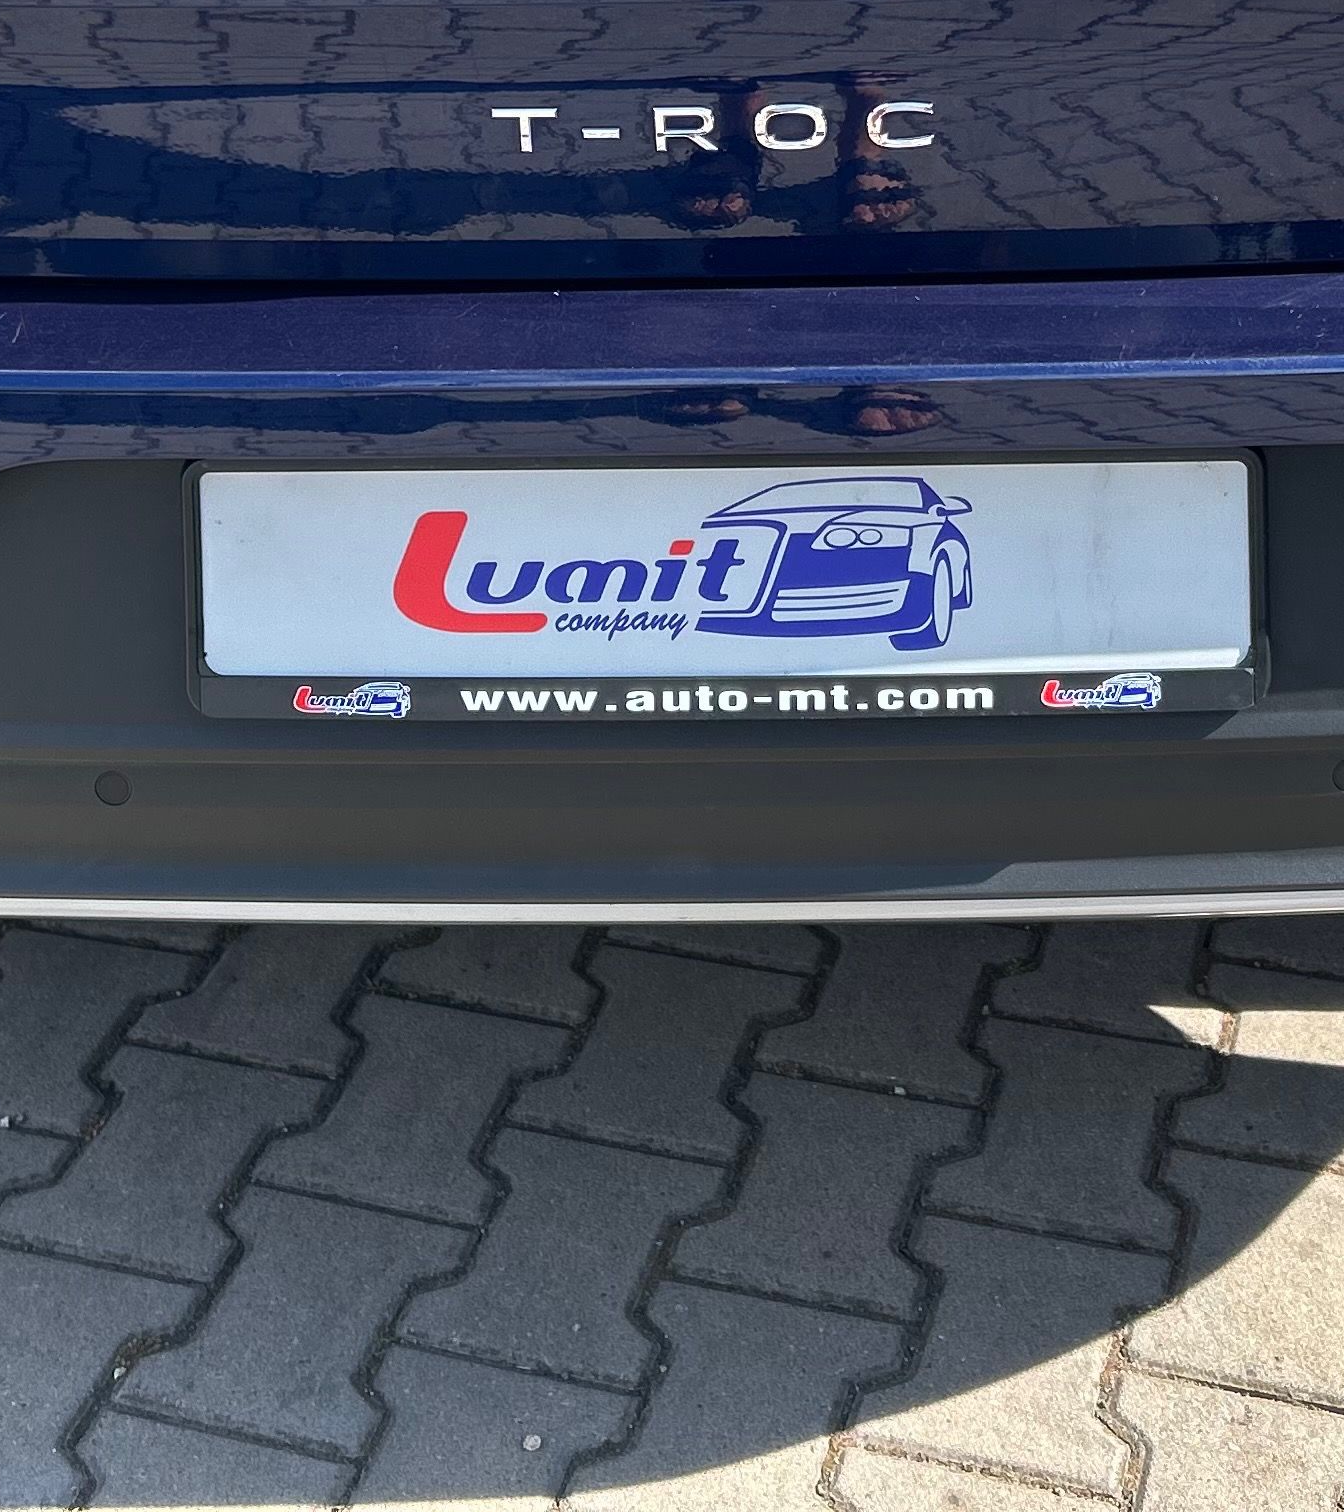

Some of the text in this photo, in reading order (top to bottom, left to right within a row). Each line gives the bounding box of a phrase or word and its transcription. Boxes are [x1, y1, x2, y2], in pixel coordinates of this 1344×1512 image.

[491, 101, 935, 153] T-ROC
[392, 510, 746, 633] Lumit
[555, 608, 689, 641] company
[460, 684, 994, 713] www.auto-mt.com
